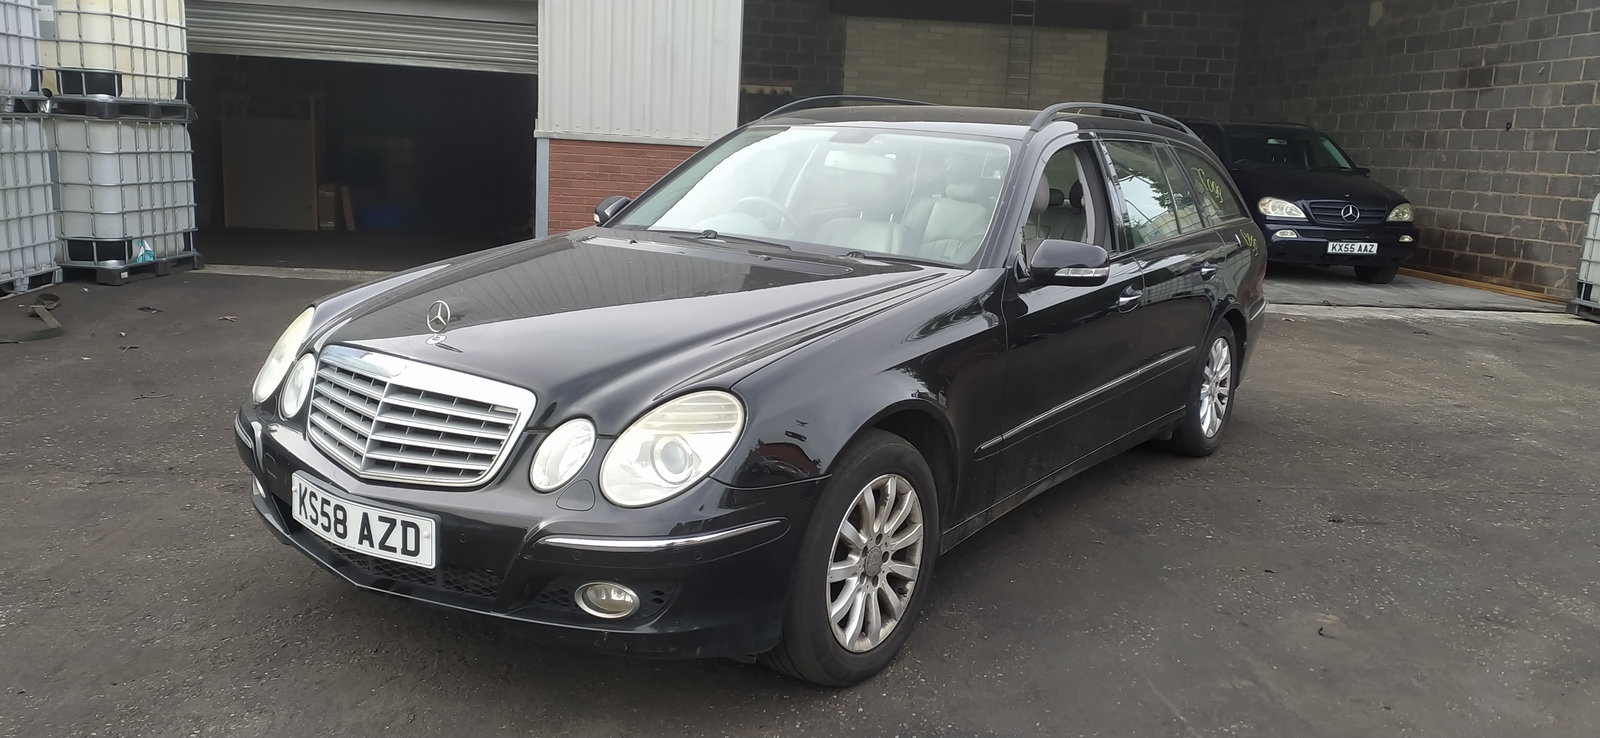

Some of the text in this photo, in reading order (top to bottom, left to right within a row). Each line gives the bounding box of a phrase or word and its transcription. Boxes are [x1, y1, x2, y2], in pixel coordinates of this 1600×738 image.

[1331, 243, 1375, 253] KX55 AAZ
[298, 482, 421, 558] KS58 AZD
